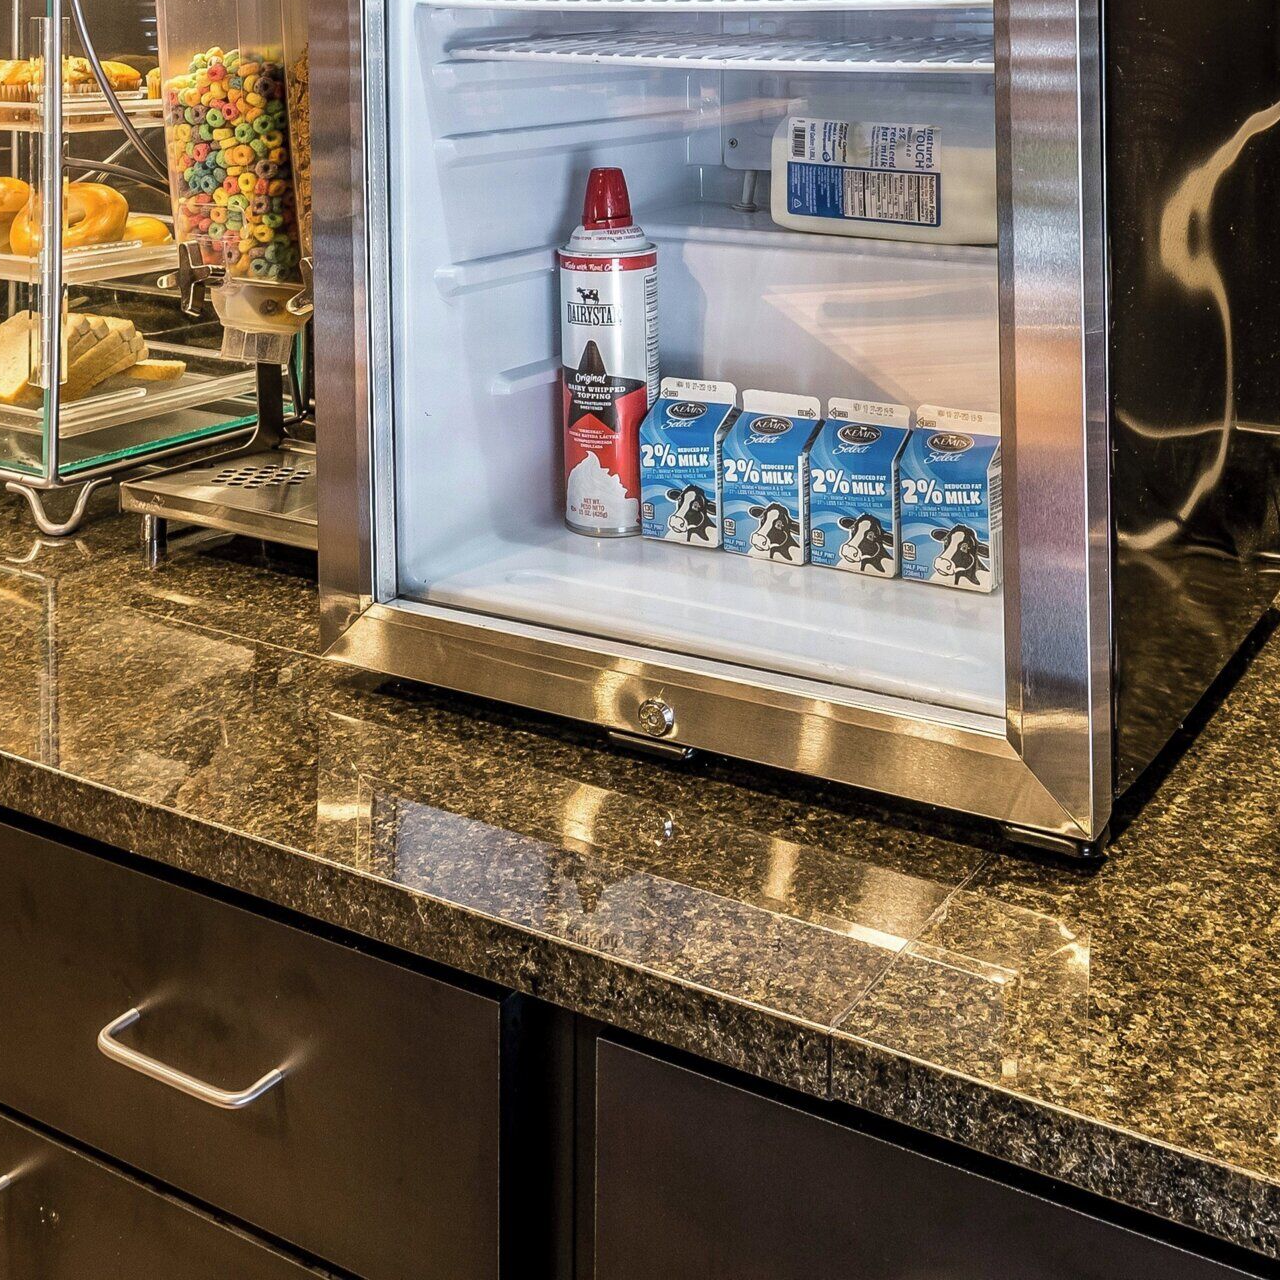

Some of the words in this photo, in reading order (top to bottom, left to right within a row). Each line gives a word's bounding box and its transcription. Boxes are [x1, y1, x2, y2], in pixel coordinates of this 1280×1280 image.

[899, 128, 906, 140] 2%
[889, 127, 897, 168] reduced
[915, 128, 926, 168] TOUCH
[926, 129, 934, 168] nature's
[568, 304, 621, 326] DAIRYSTA
[576, 373, 607, 384] Original
[568, 383, 586, 392] DAIRY
[577, 392, 611, 400] TOPPING
[661, 419, 695, 430] Select
[744, 434, 780, 445] Select
[832, 442, 870, 454] Select
[641, 444, 676, 467] 2%
[678, 454, 709, 467] MILK
[924, 452, 963, 464] Select
[723, 459, 759, 483] 2%
[762, 471, 793, 484] MILK
[811, 469, 849, 493] 2%
[852, 482, 886, 495] MILK
[901, 479, 943, 504] 2%
[945, 491, 981, 504] MILK
